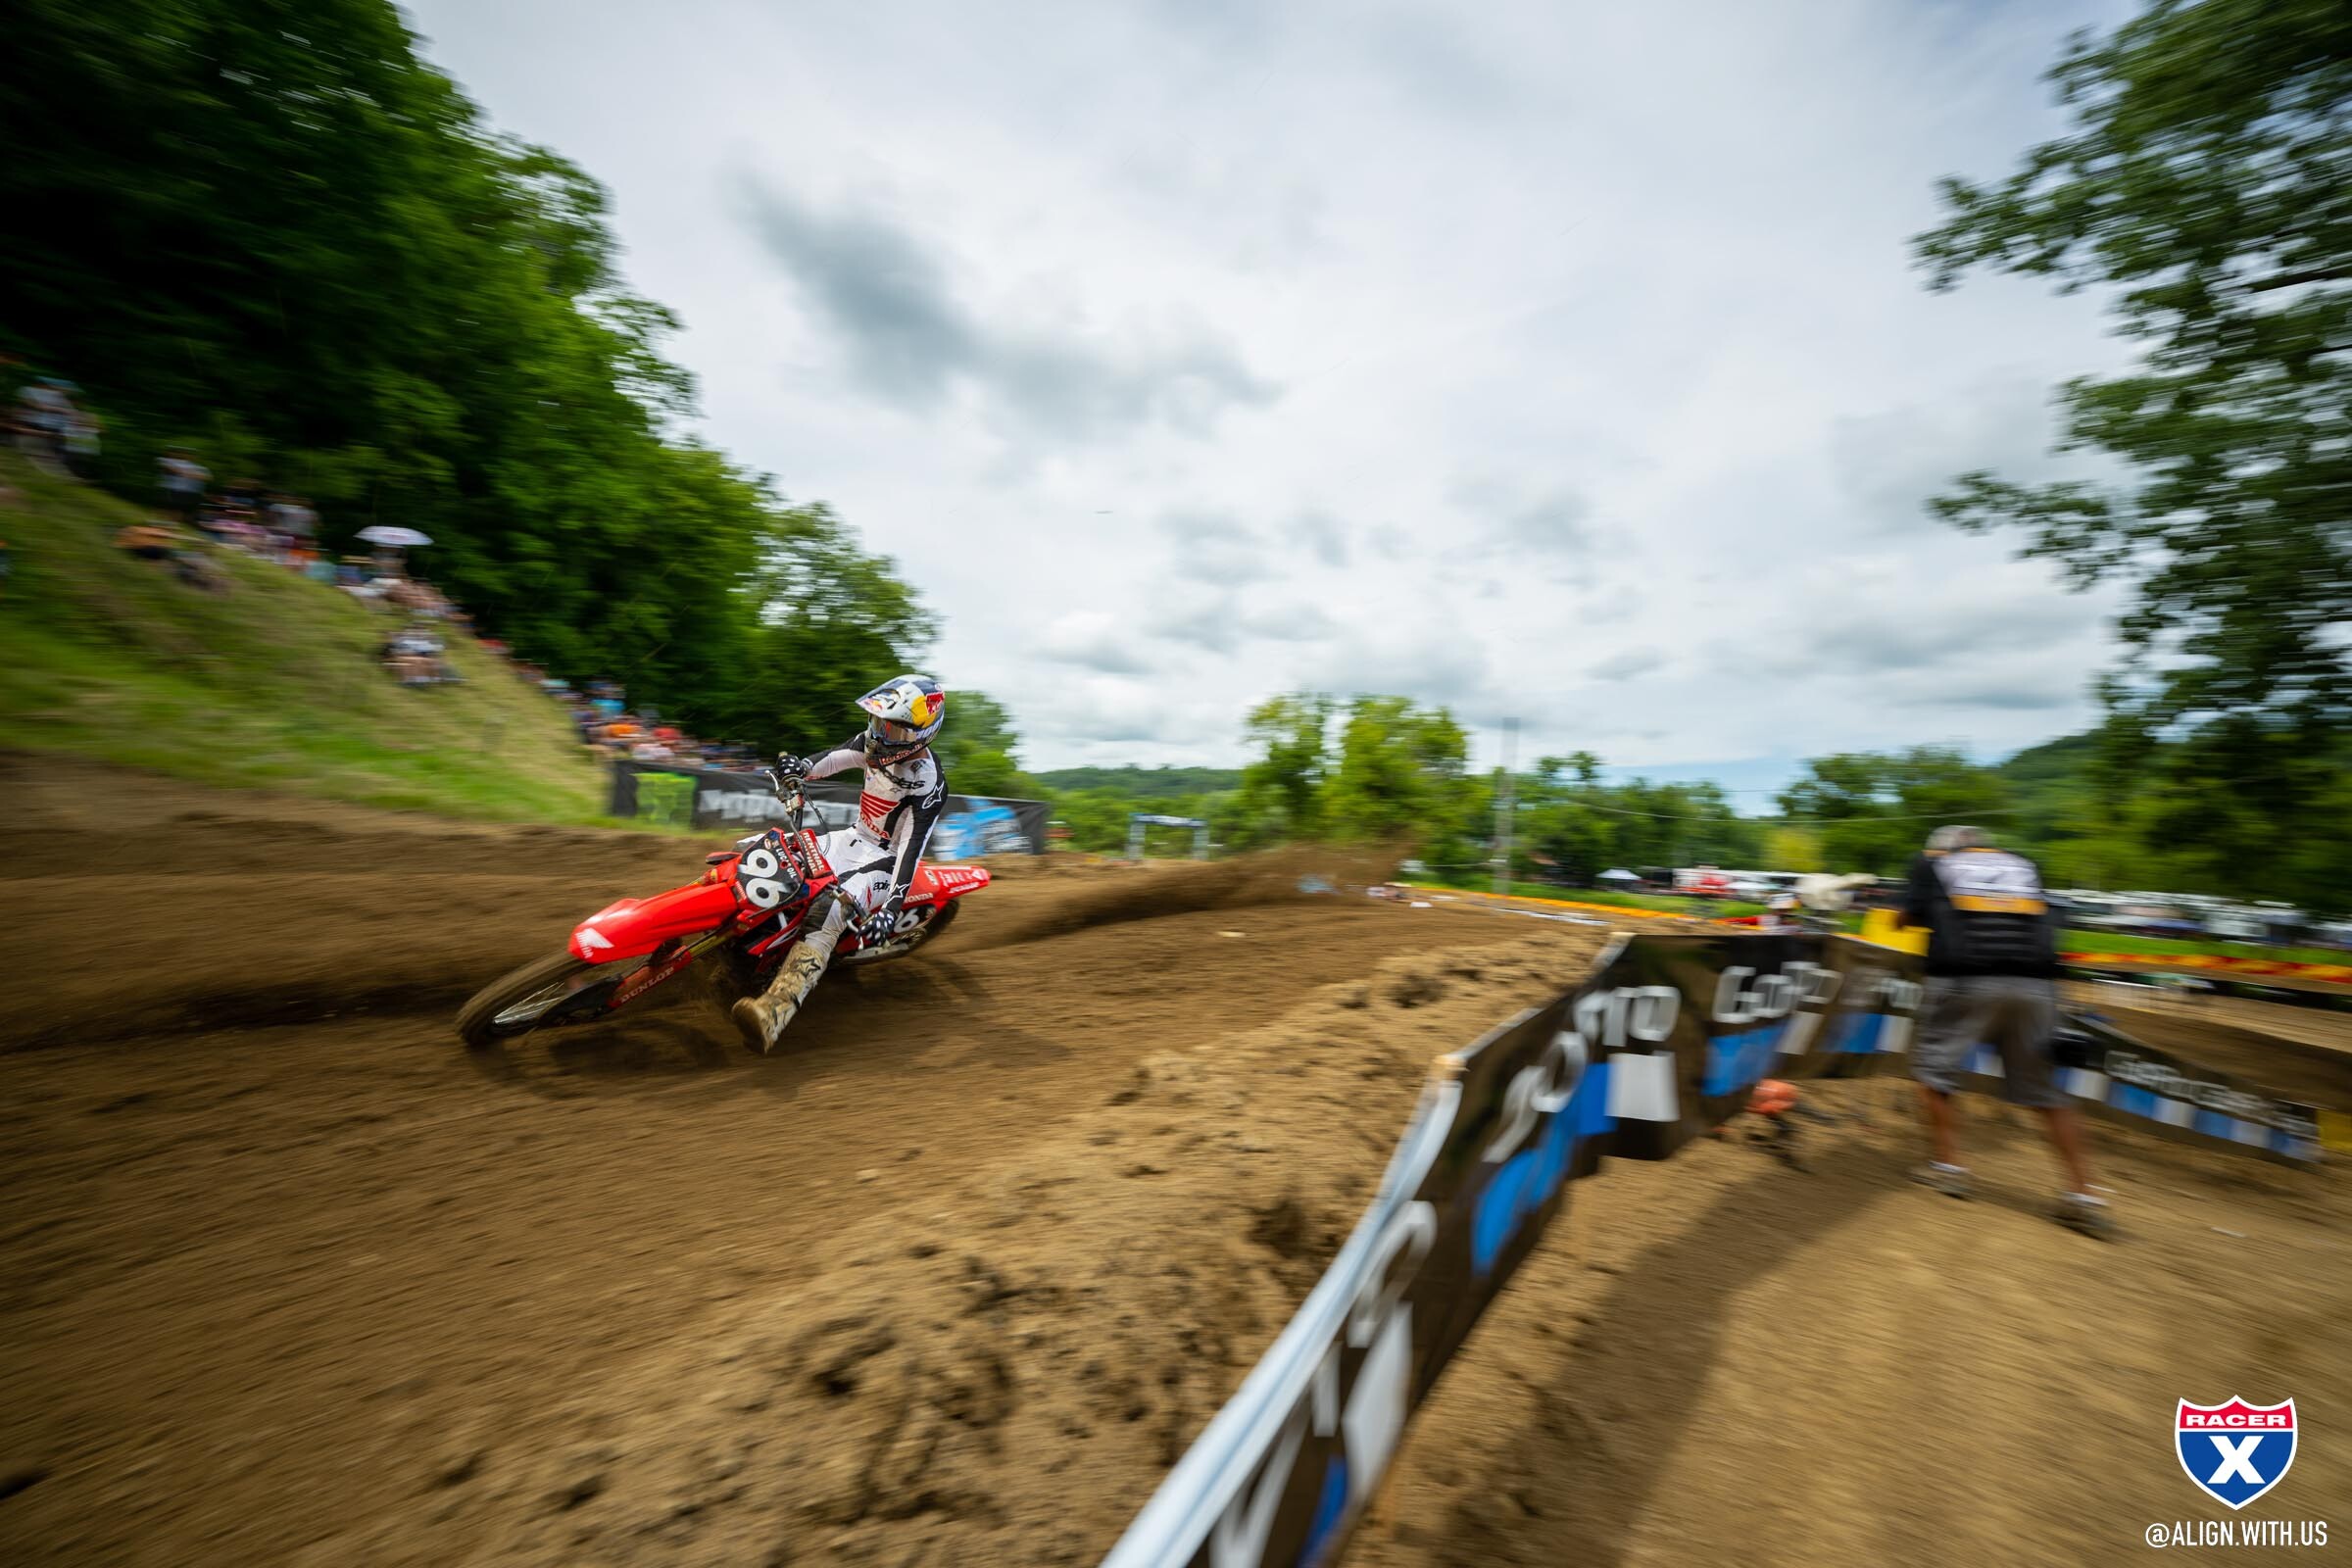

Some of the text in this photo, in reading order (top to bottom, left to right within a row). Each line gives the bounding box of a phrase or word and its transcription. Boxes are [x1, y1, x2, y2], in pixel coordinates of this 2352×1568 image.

[860, 811, 892, 840] ONDA
[803, 832, 825, 871] RENTHAL
[737, 848, 792, 908] 96
[786, 866, 798, 879] OIL
[620, 966, 675, 1004] DUNLOP
